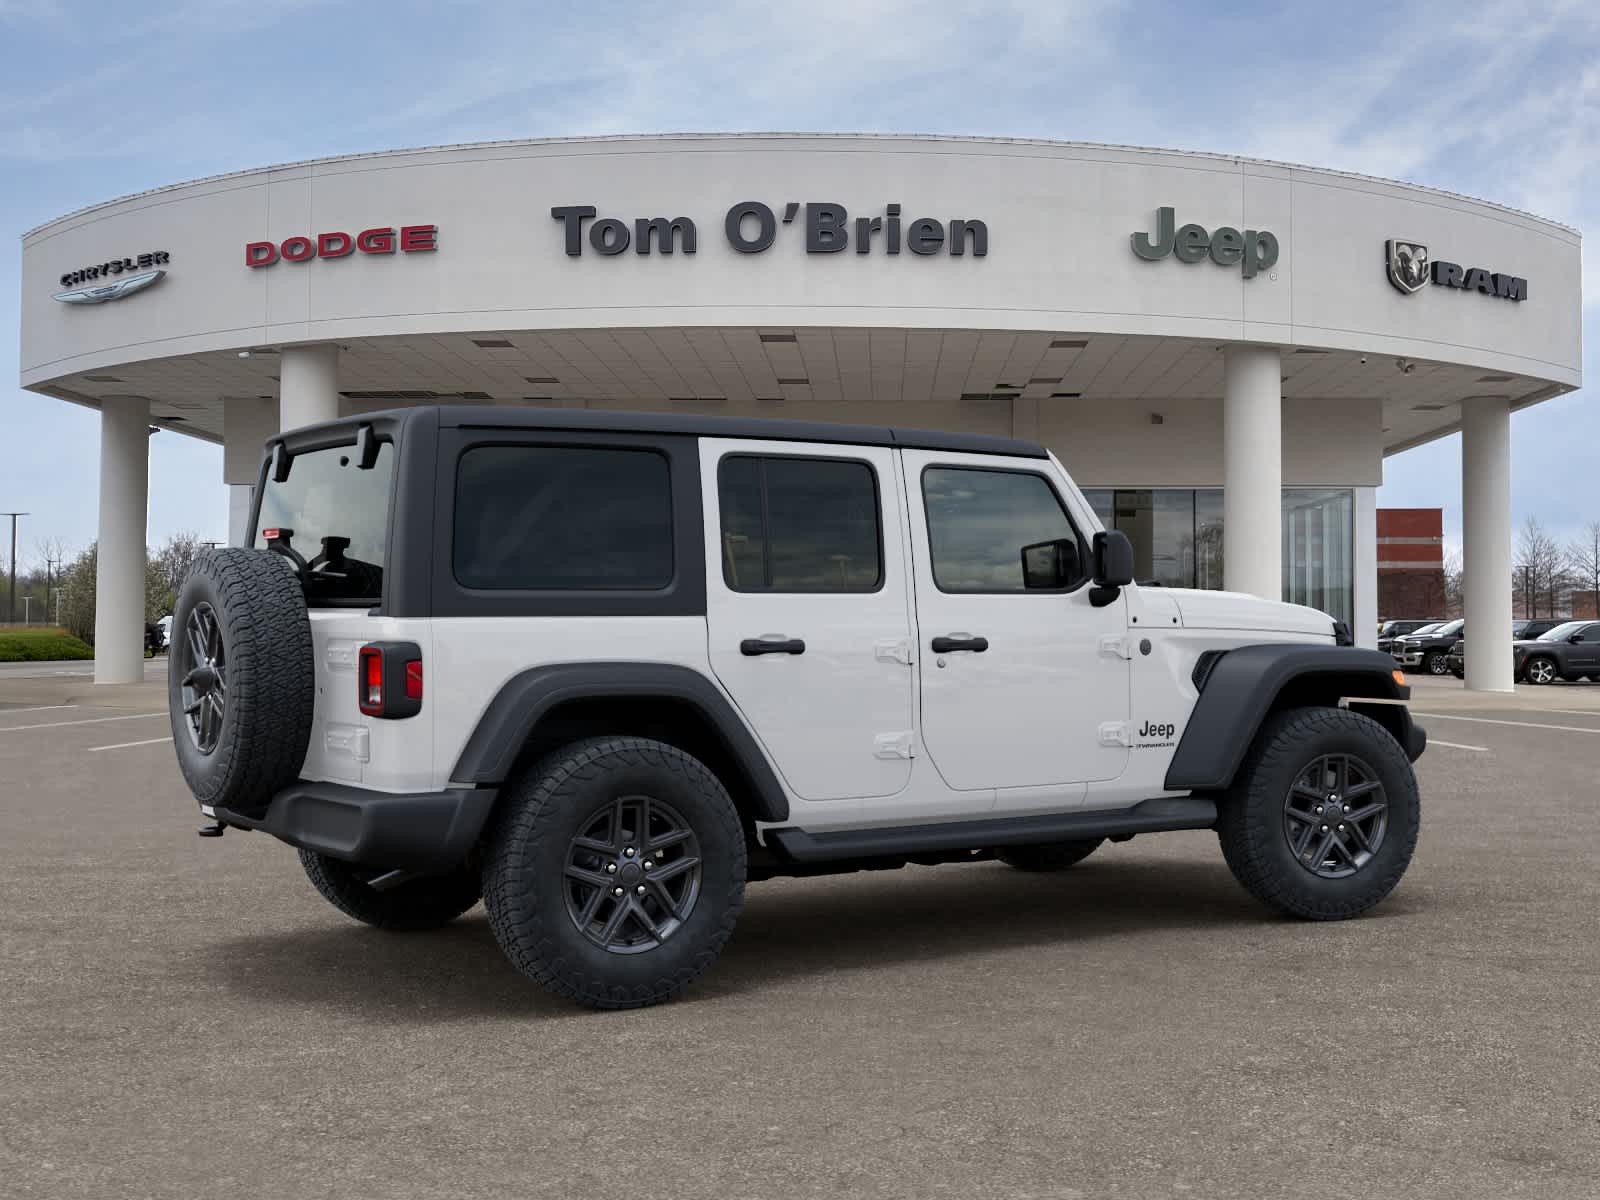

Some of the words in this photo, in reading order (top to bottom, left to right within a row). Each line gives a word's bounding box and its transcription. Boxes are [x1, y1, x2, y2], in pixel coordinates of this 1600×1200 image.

[245, 225, 438, 269] DODGE
[551, 205, 697, 256] Tom
[725, 201, 988, 256] O'Brien
[1130, 206, 1279, 279] Jeep
[60, 251, 170, 288] CHRYSLER
[1431, 260, 1528, 301] RAM
[1139, 720, 1175, 739] Jeep
